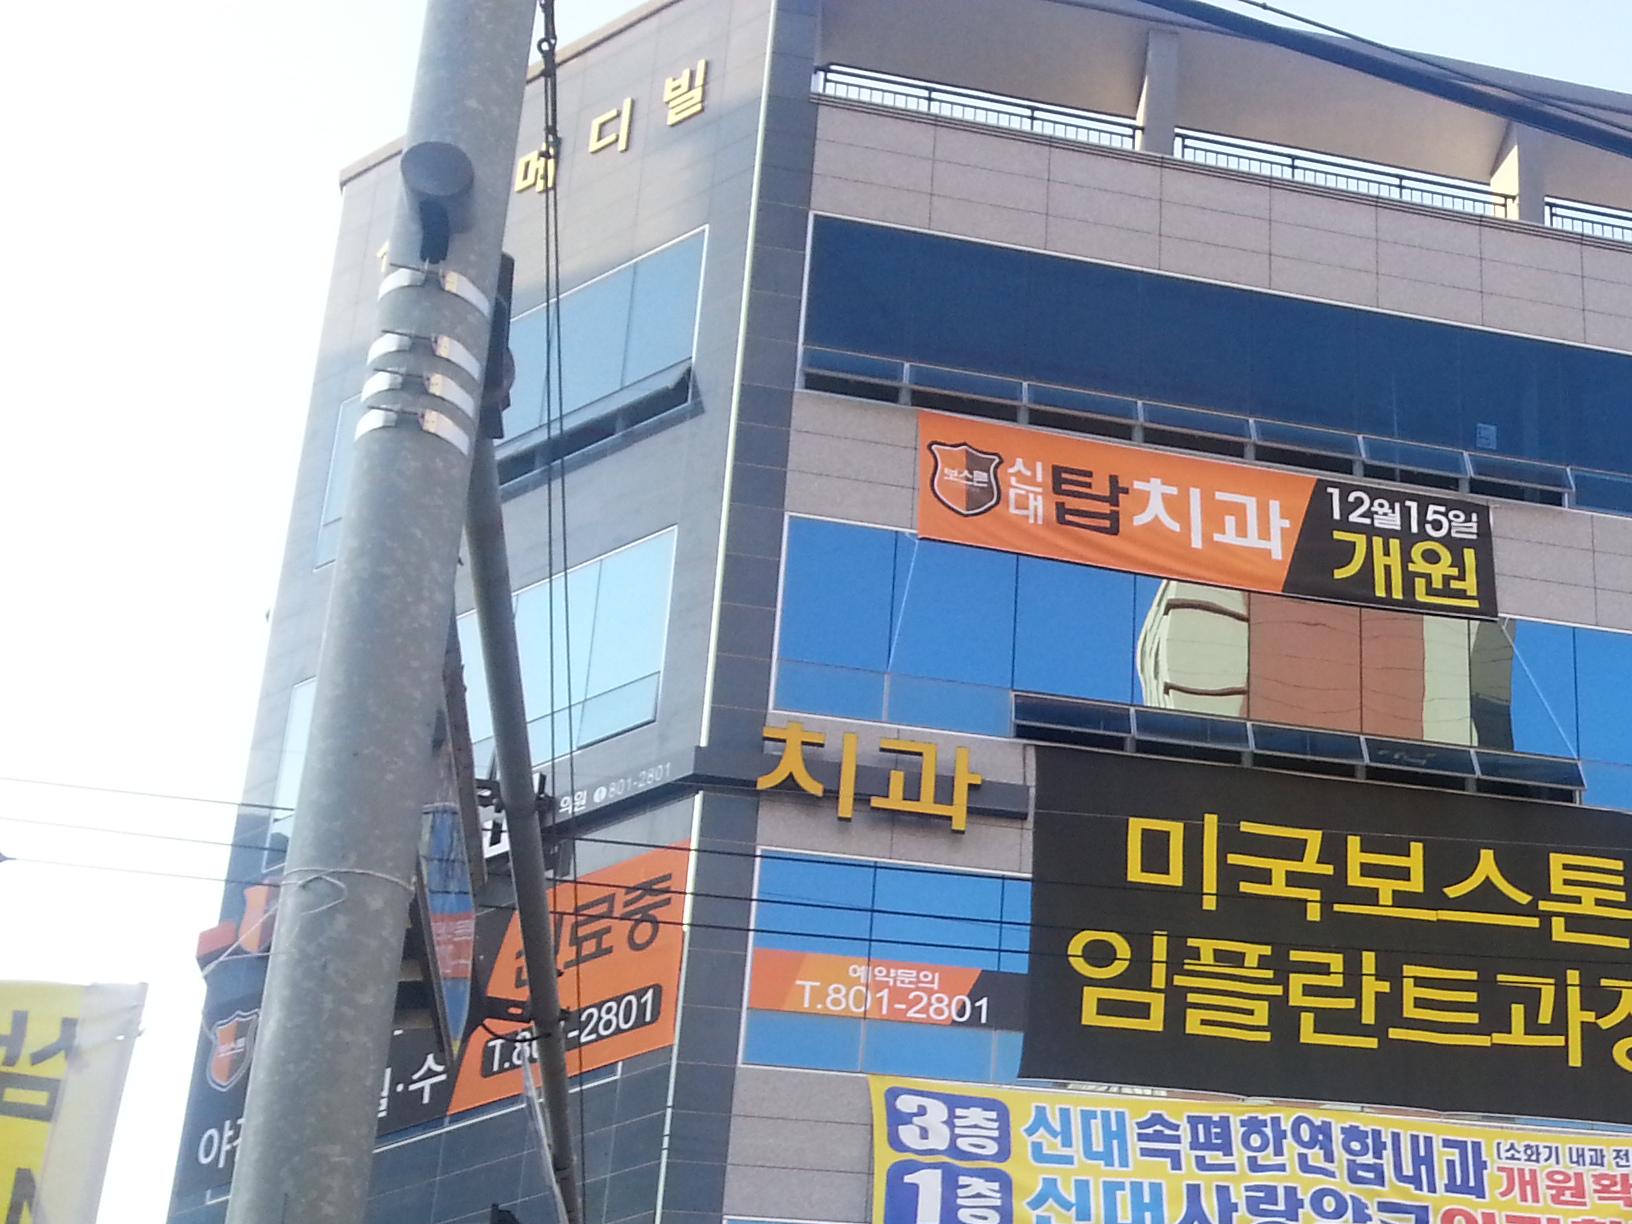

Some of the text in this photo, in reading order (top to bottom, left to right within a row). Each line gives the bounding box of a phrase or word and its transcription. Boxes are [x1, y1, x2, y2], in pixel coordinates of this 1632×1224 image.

[1326, 487, 1478, 540] 12월15일
[1332, 530, 1481, 608] 개원
[607, 762, 672, 799] 801-2801
[756, 721, 982, 833] 치과
[848, 964, 940, 990] 예약문의
[795, 979, 989, 1025] T.801-2801
[893, 1091, 1001, 1157] 3층
[1496, 1140, 1561, 1167] (소화기
[1568, 1147, 1606, 1168] 내과
